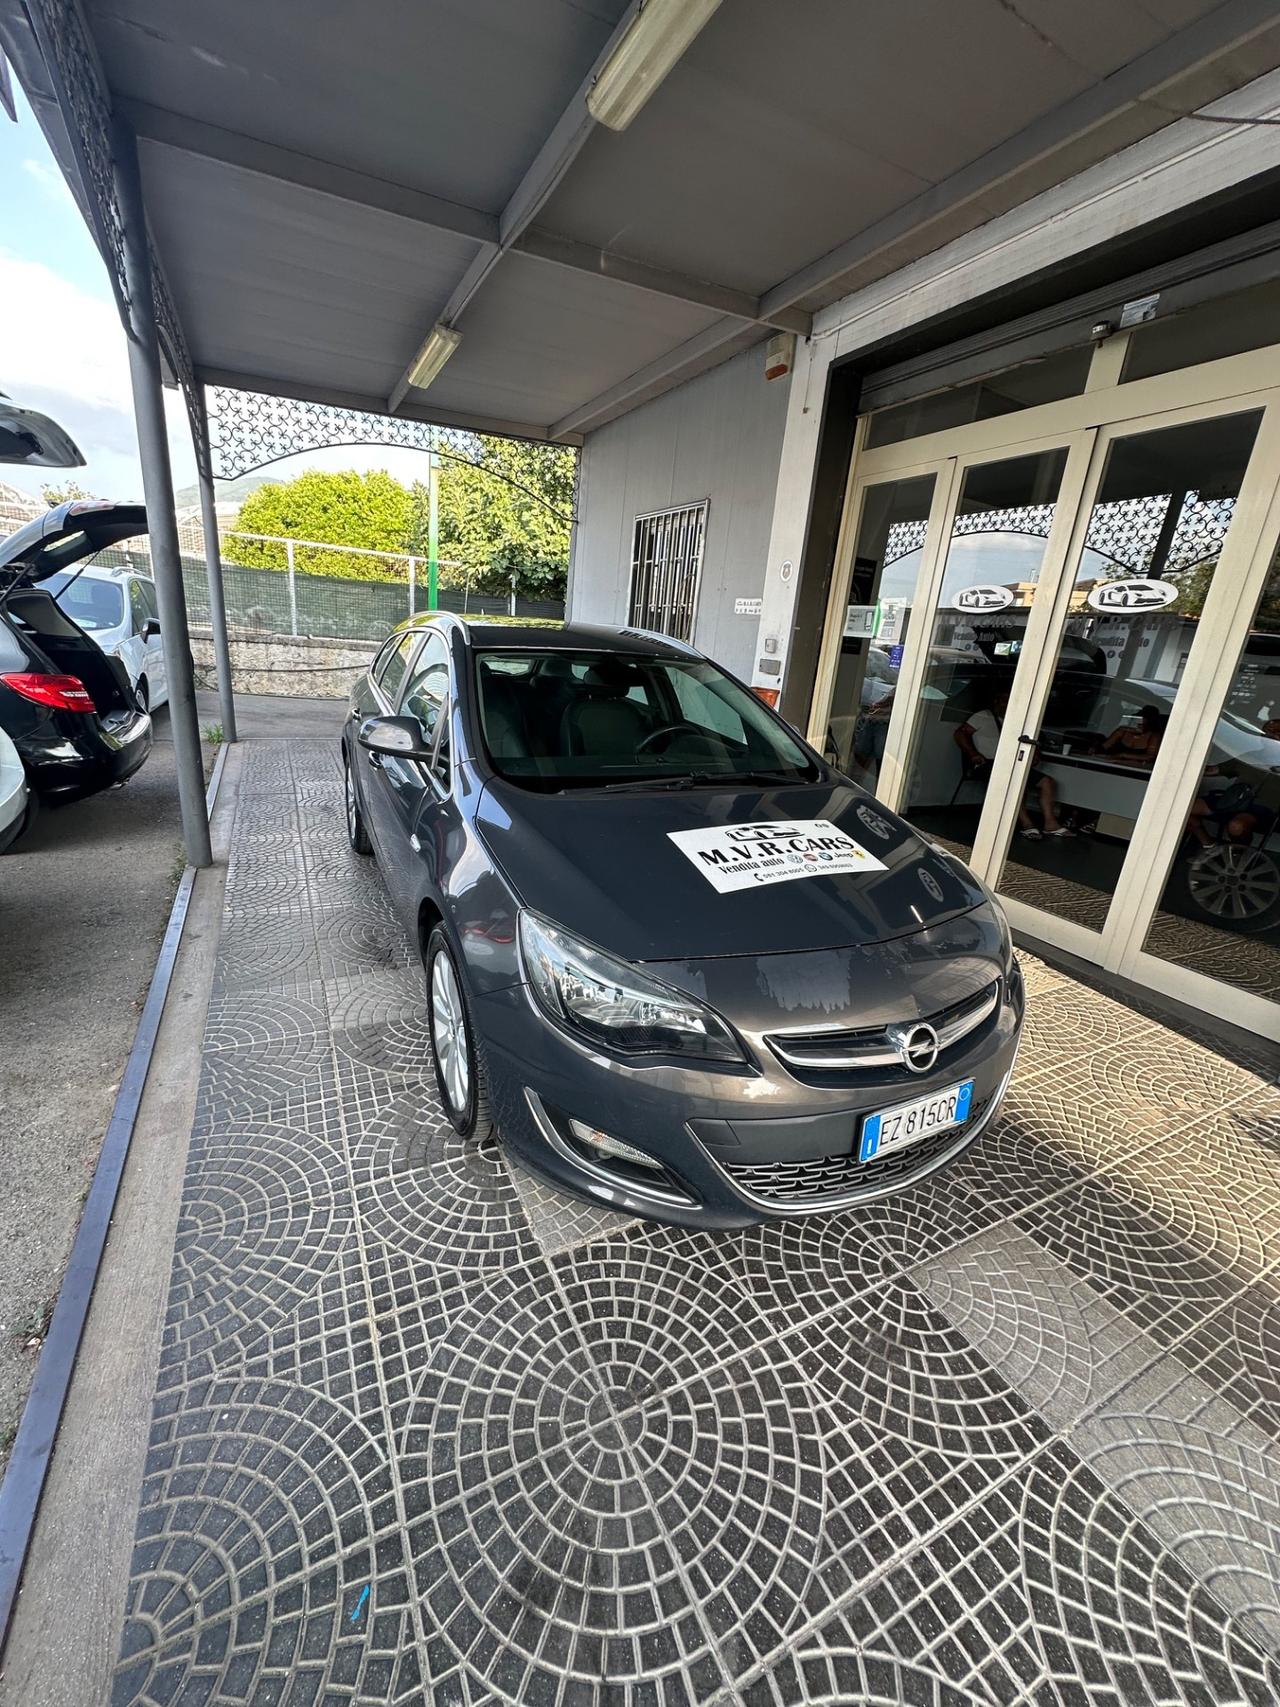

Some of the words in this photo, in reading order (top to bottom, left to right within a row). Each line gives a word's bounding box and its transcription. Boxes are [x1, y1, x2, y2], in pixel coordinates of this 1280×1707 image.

[697, 837, 855, 866] M.V.R.CARS
[718, 861, 761, 874] Vendita
[760, 857, 785, 868] auto
[880, 1116, 902, 1145] EZ
